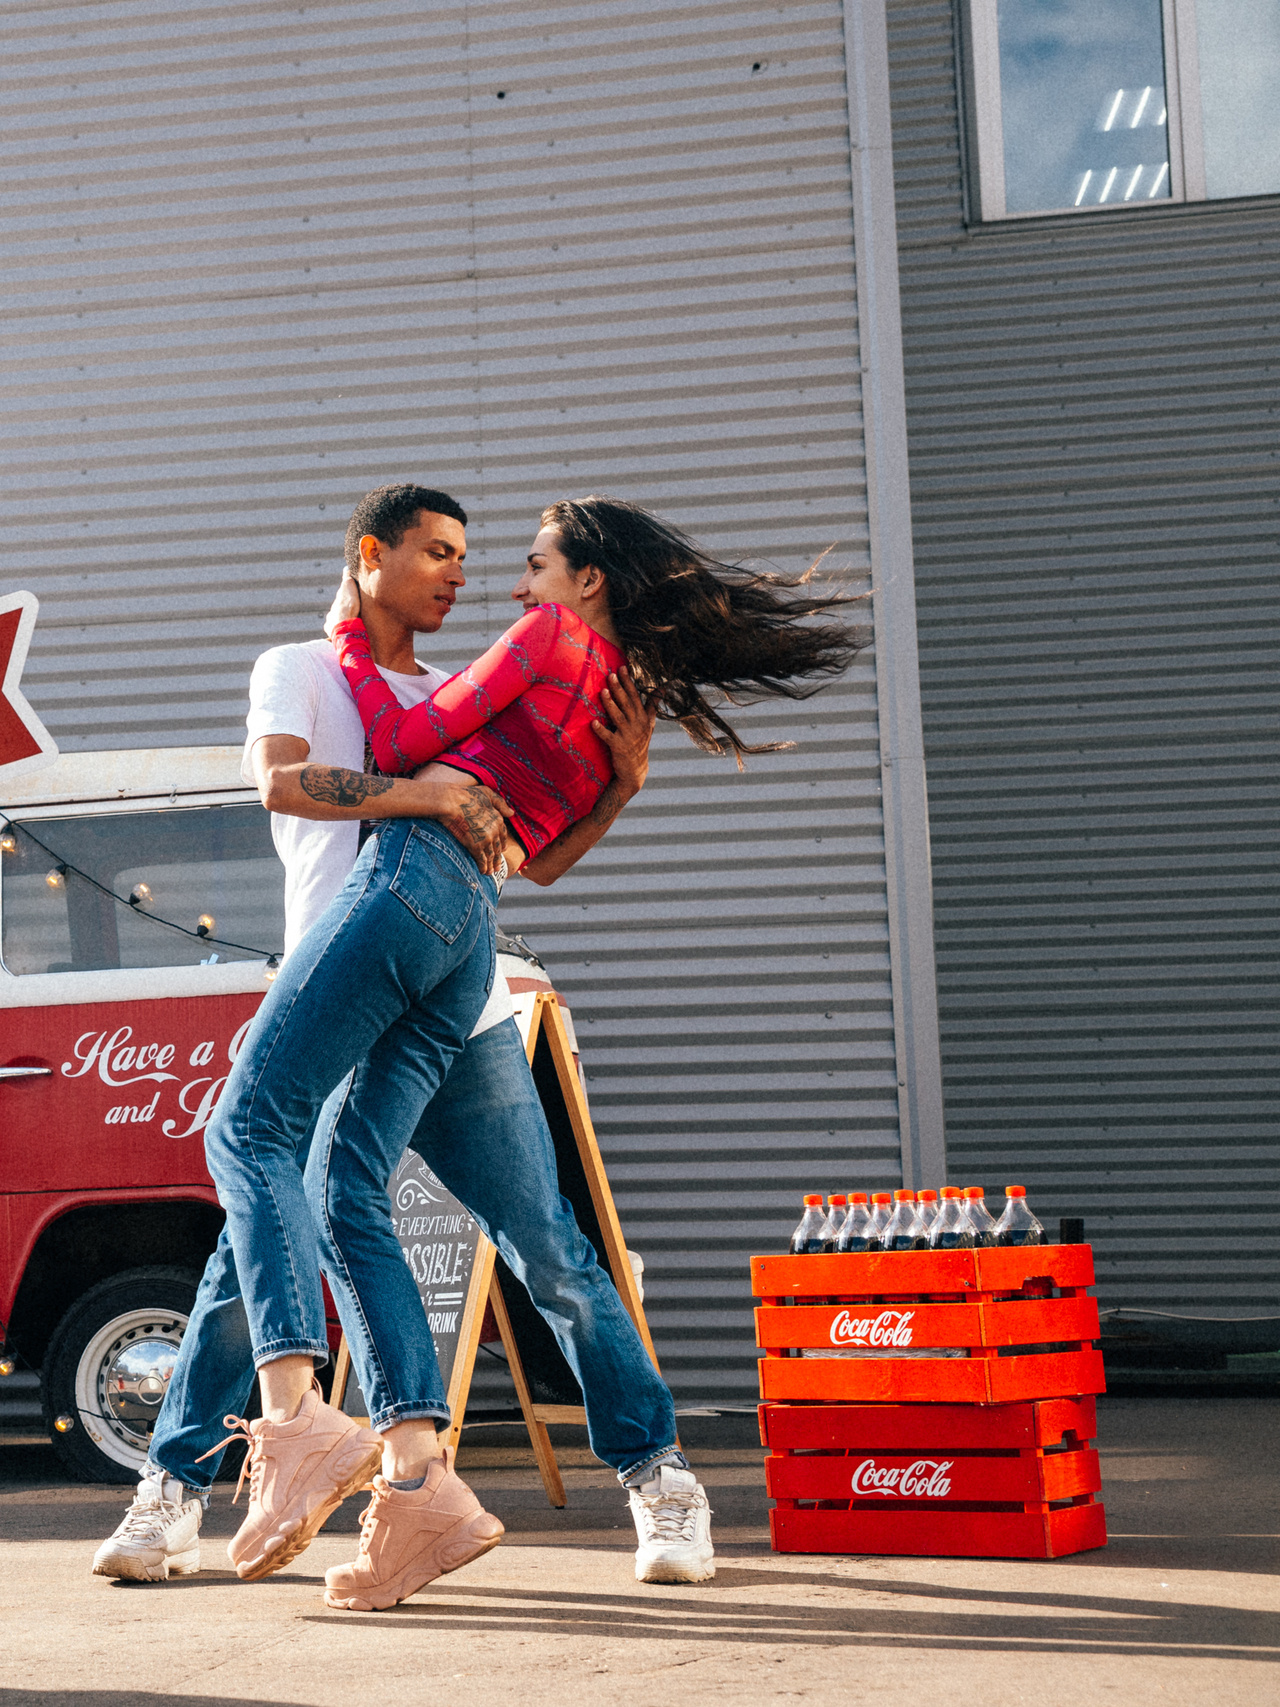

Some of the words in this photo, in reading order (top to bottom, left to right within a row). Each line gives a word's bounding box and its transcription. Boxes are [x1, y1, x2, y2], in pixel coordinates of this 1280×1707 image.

[60, 1025, 181, 1087] Have
[189, 1040, 216, 1067] a
[104, 1091, 161, 1125] and
[398, 1213, 466, 1237] EVERYTHING
[427, 1311, 459, 1334] DRINK
[829, 1309, 915, 1347] Coca-Cola
[850, 1458, 954, 1497] Coca-Cola
